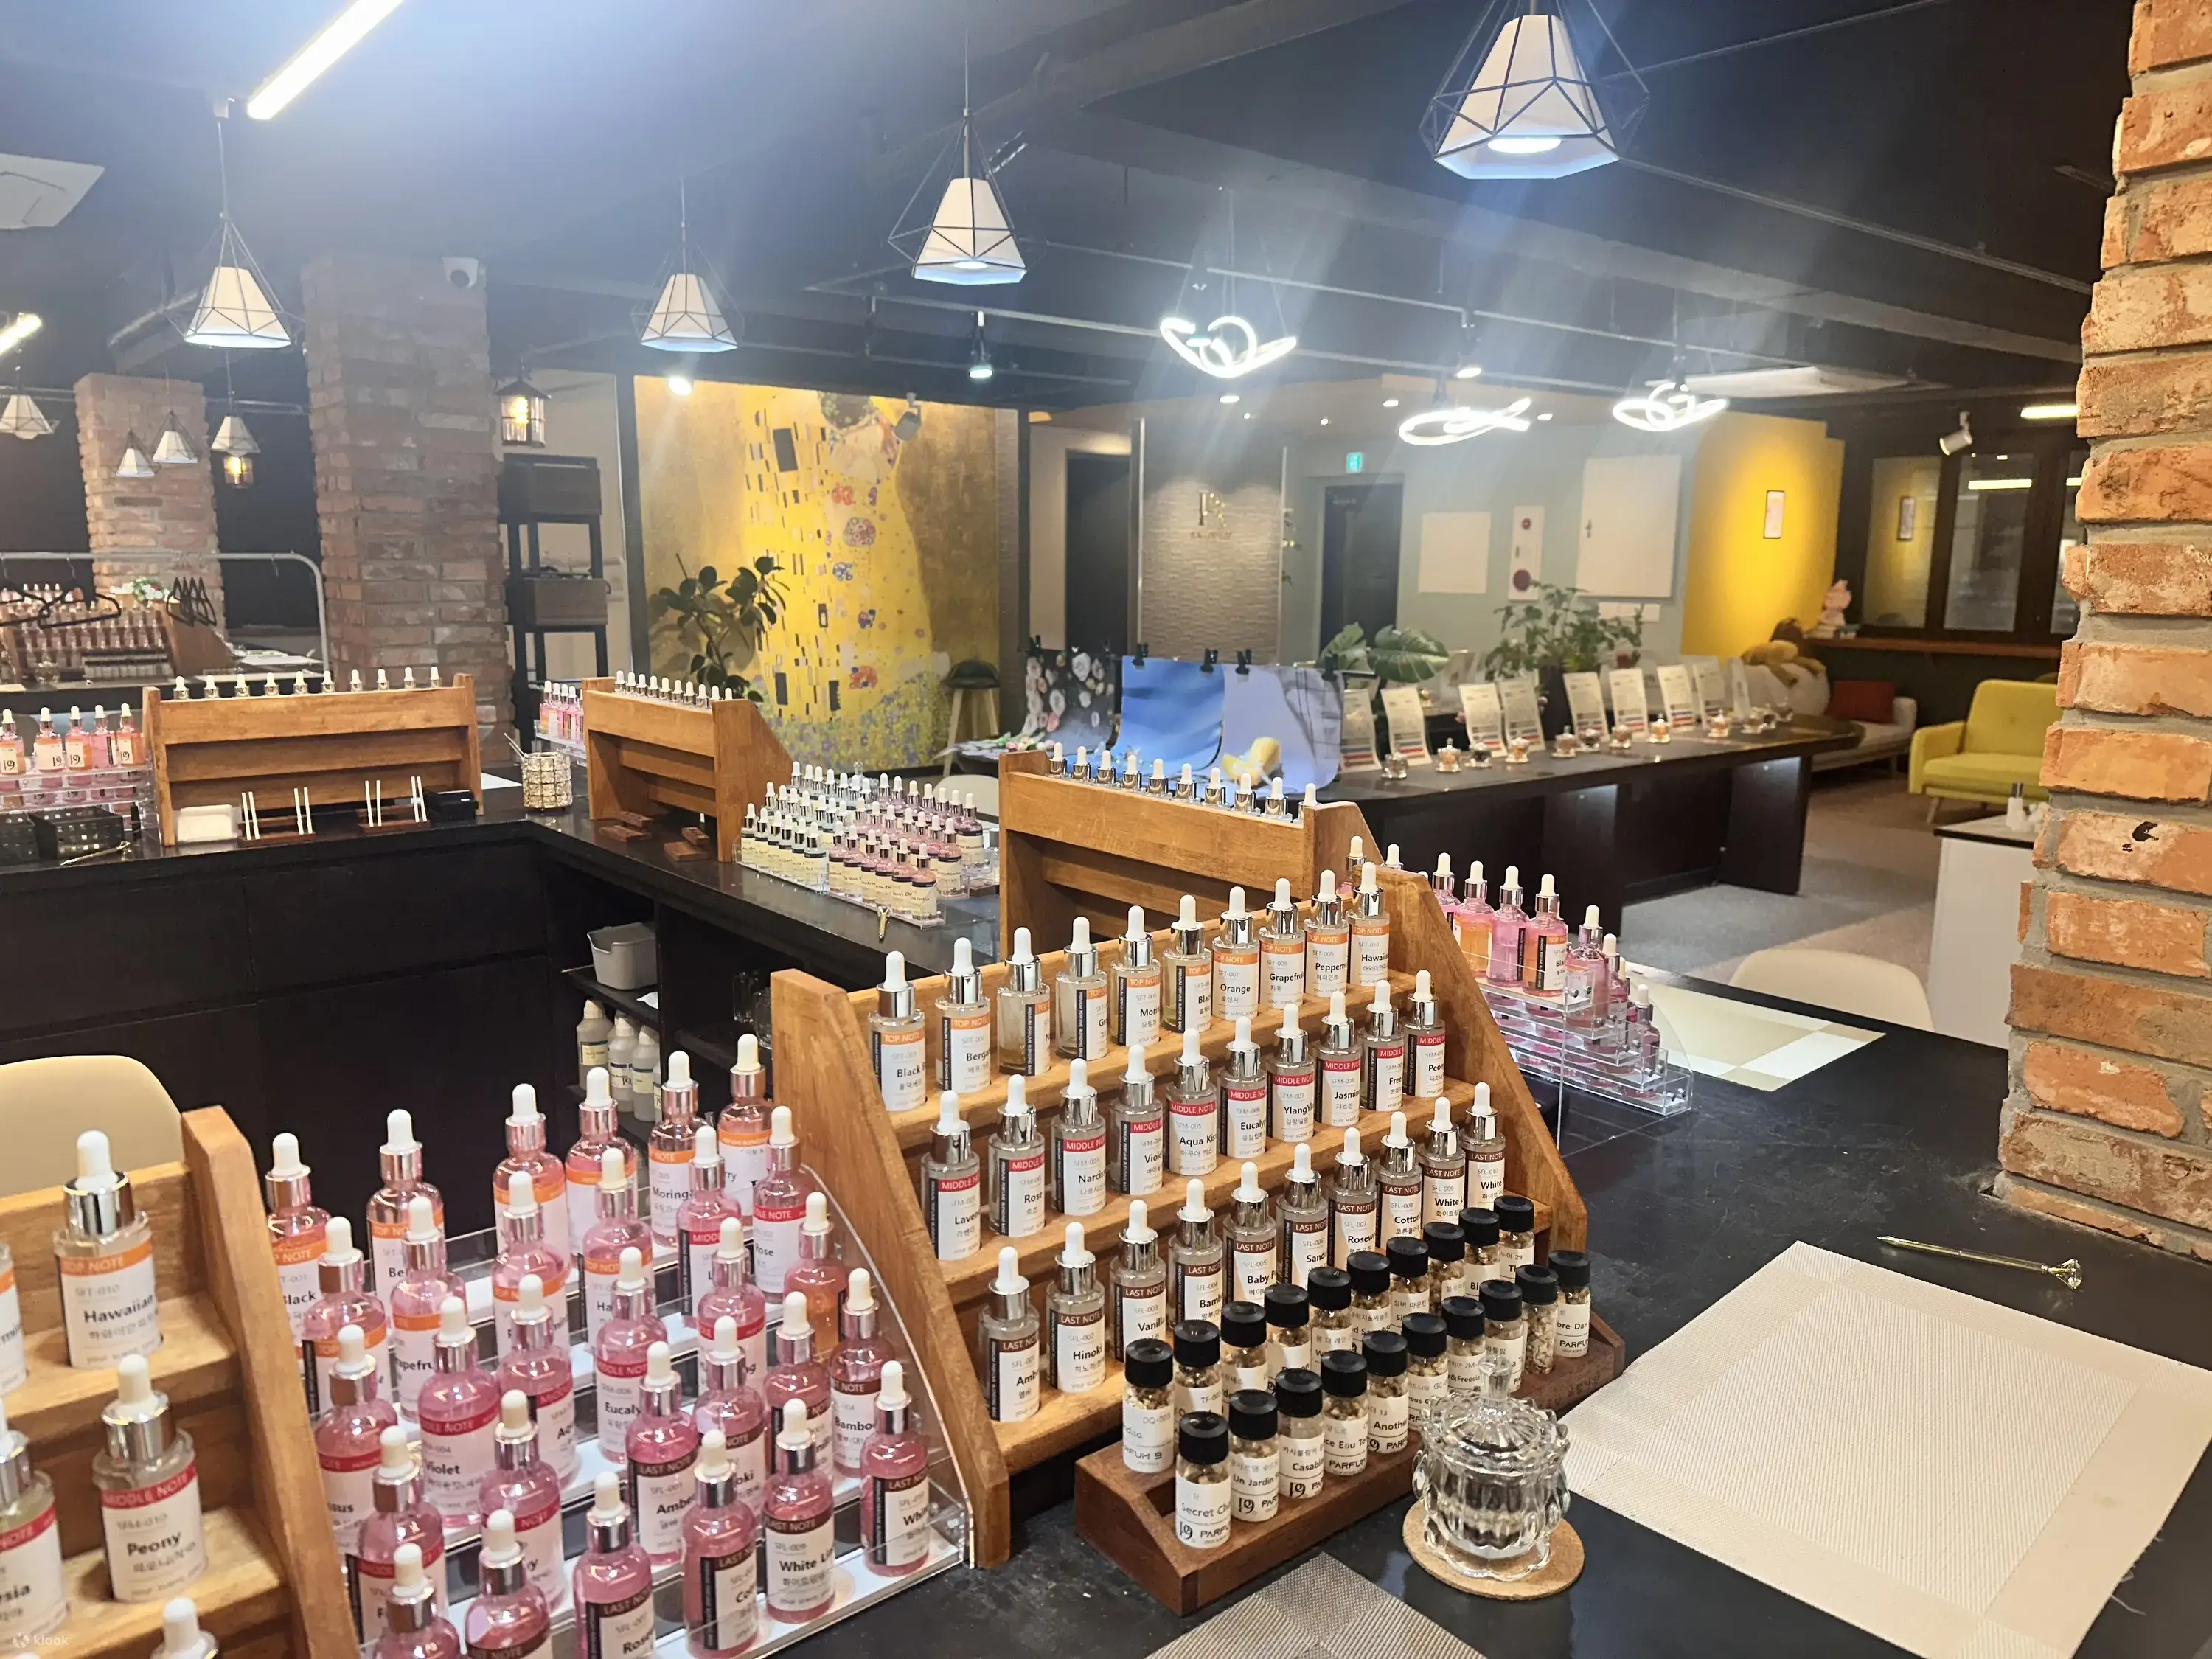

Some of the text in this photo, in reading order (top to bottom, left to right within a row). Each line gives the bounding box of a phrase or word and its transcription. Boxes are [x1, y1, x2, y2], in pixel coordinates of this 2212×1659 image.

[1274, 945, 1293, 953] NOTE
[1187, 967, 1201, 975] TOP
[1129, 978, 1144, 986] TOP
[1220, 984, 1251, 995] Orange
[953, 1020, 970, 1028] TOP
[884, 1032, 921, 1043] TOP NOTE
[1419, 1036, 1442, 1045] MIDDLE
[1325, 1061, 1351, 1070] MIDDLE
[897, 1065, 921, 1078] Black
[1273, 1075, 1300, 1085] MIDDLE
[1230, 1090, 1256, 1099] MIDDLE
[1171, 1102, 1215, 1114] MIDDLE NOTE
[1283, 1105, 1307, 1116] Ylang
[1133, 1122, 1159, 1132] MIDDLE
[1066, 1140, 1095, 1150] MIDDLE
[1179, 1136, 1204, 1150] Aqua
[655, 1152, 675, 1161] NOTE
[1471, 1152, 1503, 1161] LAST NOTE
[1012, 1158, 1040, 1170] MIDDLE
[1425, 1168, 1461, 1177] LAST NOTE
[942, 1178, 973, 1190] MIDDLE
[1385, 1184, 1419, 1194] LAST NOTE
[1480, 1180, 1503, 1190] White
[1023, 1192, 1043, 1203] Rose
[1434, 1197, 1459, 1207] White
[1338, 1203, 1373, 1212] LAST NOTE
[768, 1210, 793, 1220] NOTE
[373, 1225, 389, 1235] TOP
[1295, 1222, 1314, 1231] LAST
[754, 1242, 774, 1257] Rose
[1236, 1240, 1273, 1251] LAST NOTE
[282, 1248, 312, 1262] NOTE
[88, 1256, 124, 1270] NOTE
[1188, 1265, 1207, 1275] LAST
[1247, 1273, 1270, 1285] Baby
[1125, 1284, 1165, 1297] LAST NOTE
[84, 1294, 154, 1324] Hawaiian
[1060, 1311, 1102, 1324] LAST NOTE
[1068, 1332, 1095, 1342] SFL-002
[1003, 1340, 1023, 1351] LAST
[1073, 1345, 1102, 1360] Hinoki
[841, 1383, 865, 1393] NOTE
[445, 1422, 473, 1433] NOTE
[425, 1461, 461, 1475] Violet
[640, 1462, 667, 1475] LAST
[156, 1475, 189, 1497] NOTE
[888, 1478, 911, 1489] LAST
[1233, 1474, 1274, 1488] Un Jardin
[1181, 1501, 1214, 1517] Secret
[789, 1520, 816, 1531] NOTE
[126, 1532, 182, 1557] Peony
[718, 1553, 741, 1568] LAST
[779, 1558, 817, 1573] White
[604, 1601, 630, 1615] LAST
